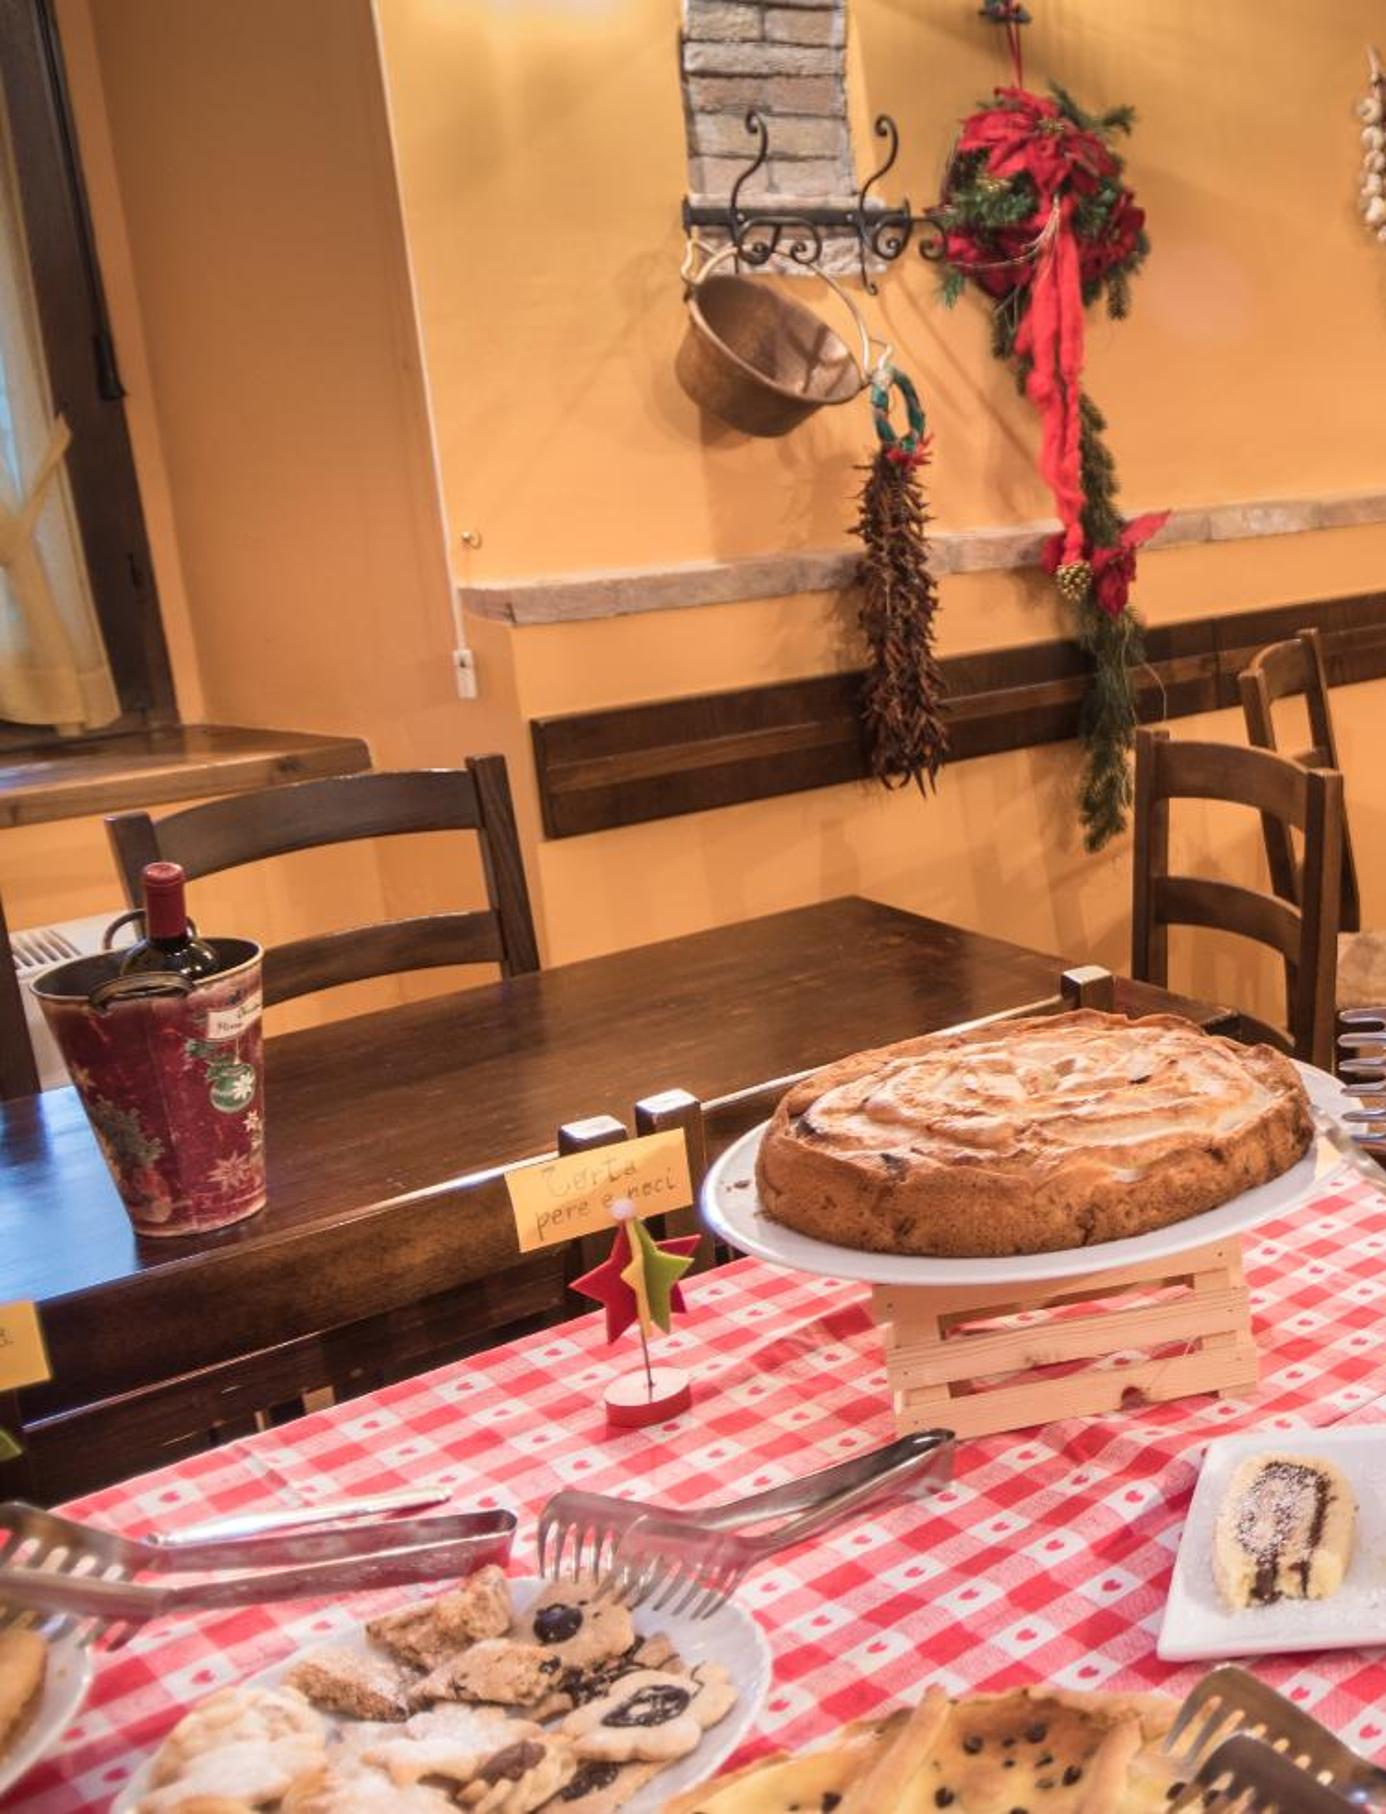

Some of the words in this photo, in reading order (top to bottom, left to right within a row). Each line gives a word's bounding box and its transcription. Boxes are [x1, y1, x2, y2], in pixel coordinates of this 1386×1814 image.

[536, 1200, 589, 1242] pere
[600, 1193, 614, 1207] e
[627, 1167, 677, 1200] noci
